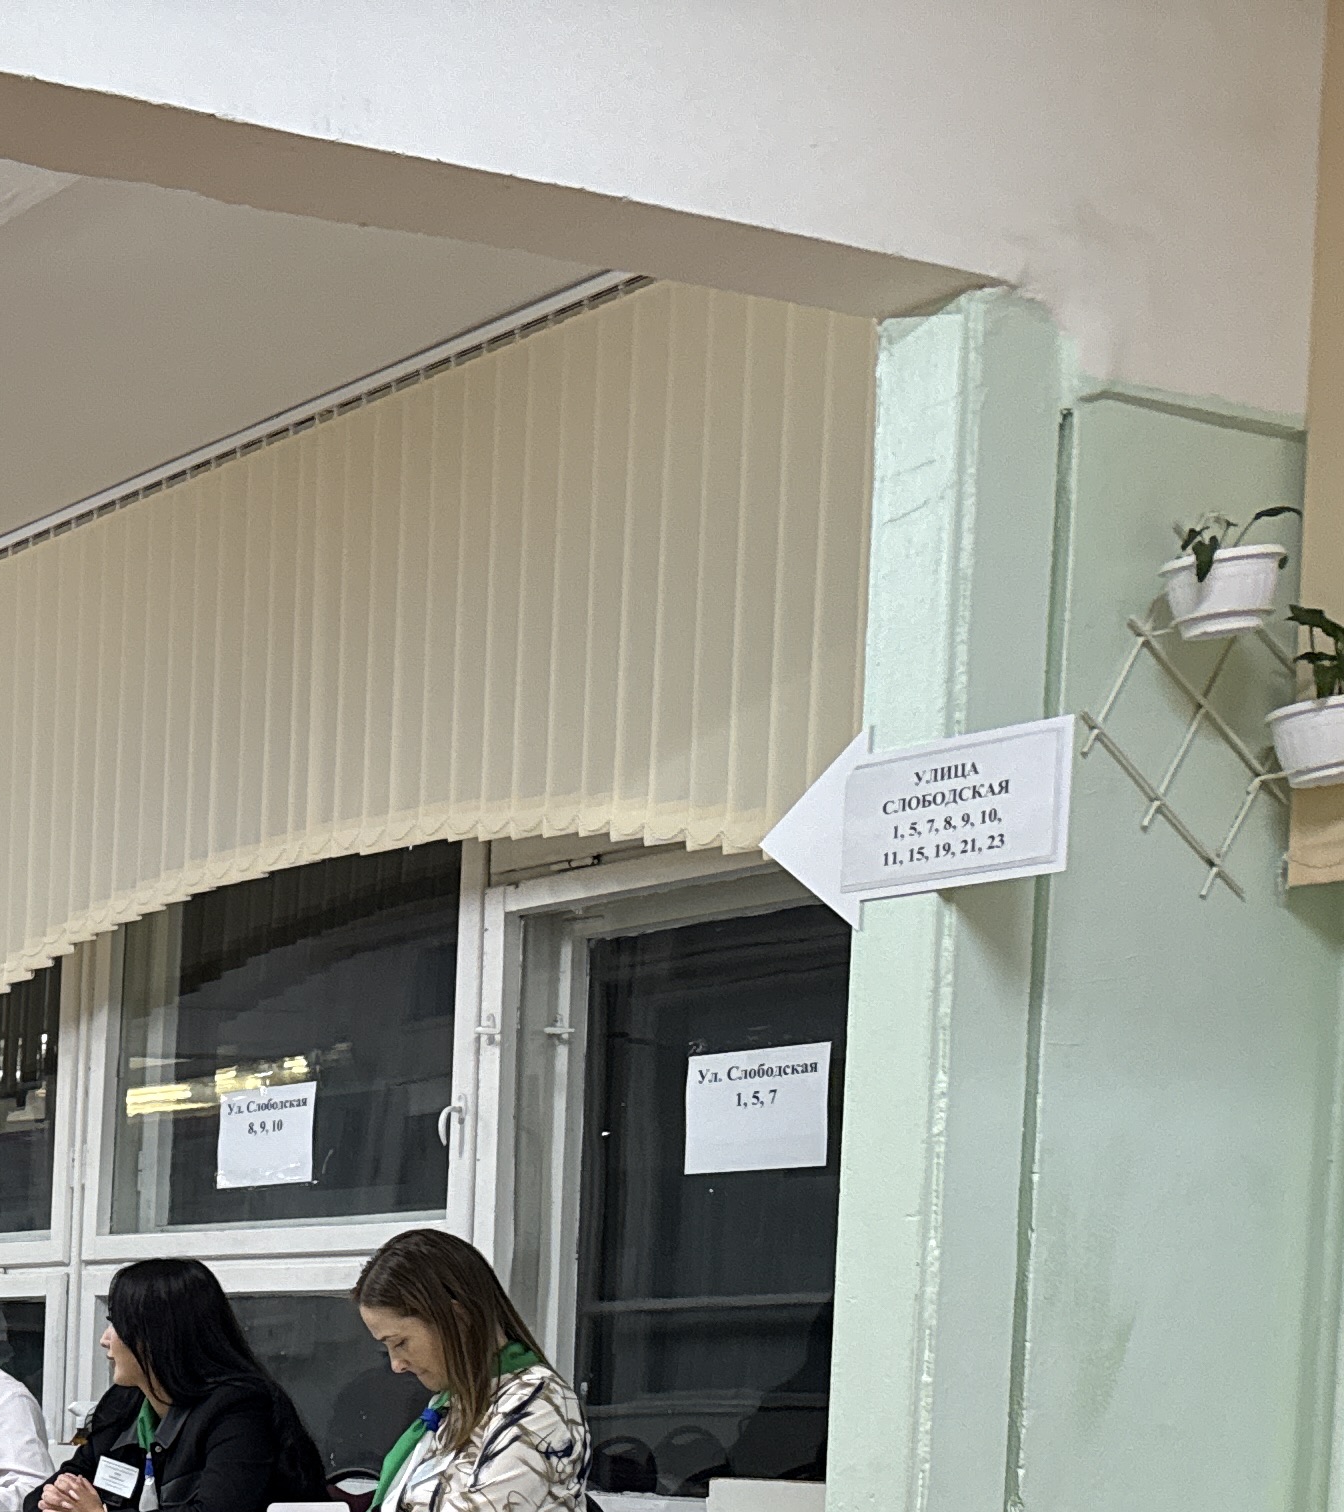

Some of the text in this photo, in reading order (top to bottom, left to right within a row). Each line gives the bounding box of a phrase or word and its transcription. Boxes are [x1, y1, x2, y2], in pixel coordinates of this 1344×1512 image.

[914, 761, 979, 787] УЛИЦА
[882, 779, 1010, 816] СЛОБОДСКАЯ
[892, 807, 1003, 840] 1, 5, 7, 8, 9, 10,
[883, 832, 1005, 867] 11, 15, 19, 21, 23
[698, 1061, 819, 1084] Ул. Слободская
[247, 1097, 308, 1113] Слободская
[736, 1089, 778, 1109] 1, 5, 7
[272, 1118, 283, 1132] 10
